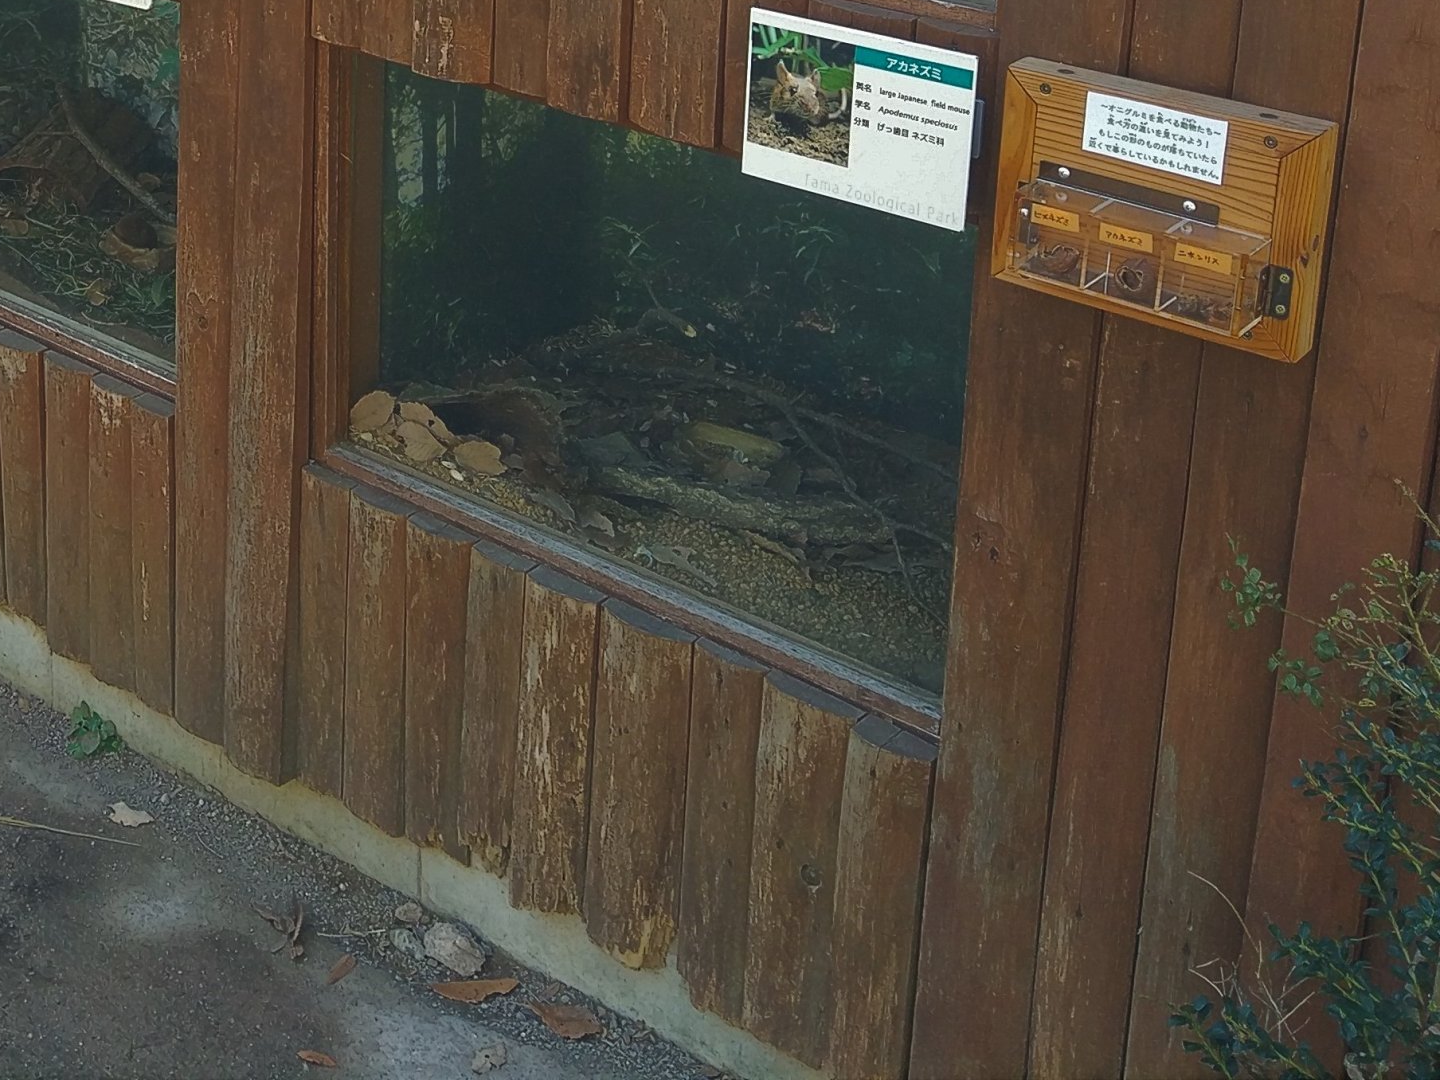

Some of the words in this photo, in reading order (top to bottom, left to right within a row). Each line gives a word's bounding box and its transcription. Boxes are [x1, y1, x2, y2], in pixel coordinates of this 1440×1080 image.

[886, 57, 942, 81] アカネズミ
[854, 99, 871, 111] 学名
[878, 106, 920, 122] Apodemus
[855, 81, 872, 93] 英名
[879, 87, 896, 99] large
[897, 92, 928, 105] Japanese
[931, 99, 946, 110] field
[947, 105, 971, 116] mouse
[853, 117, 870, 129] 分類
[911, 131, 945, 147] ネズミ科
[1098, 129, 1218, 165] もしこの形のものが落ちていたら
[1088, 139, 1219, 180] 近くで暮らしているかもしれません。
[804, 173, 839, 194] Tama
[845, 184, 920, 216] Zoological
[927, 206, 959, 225] Park
